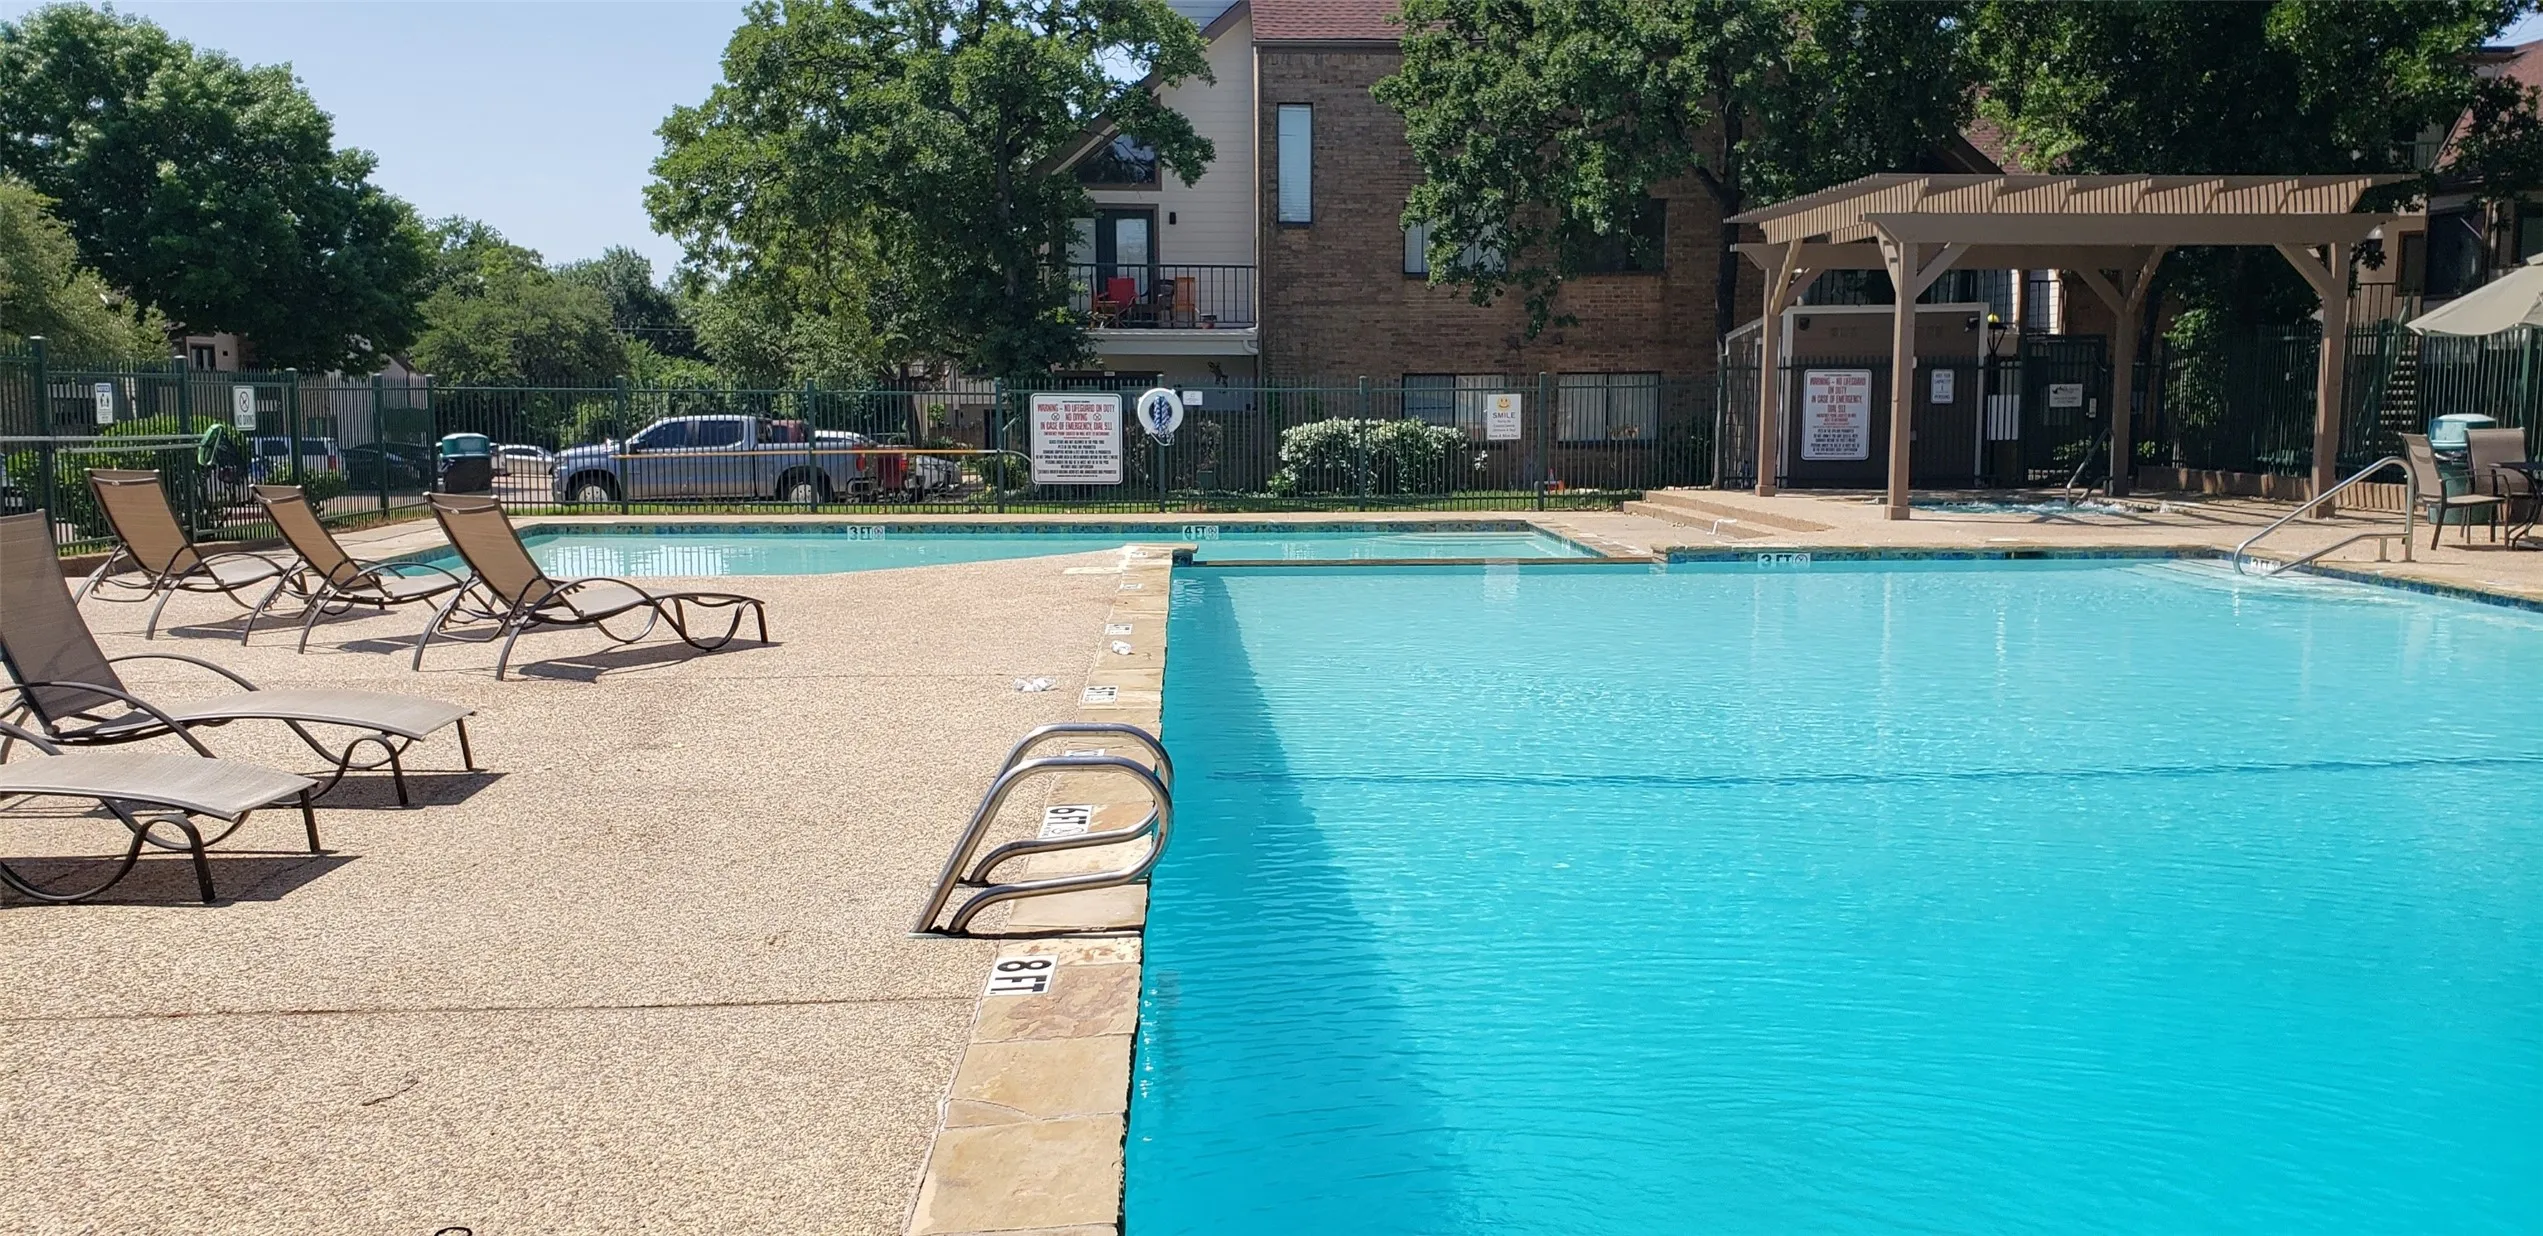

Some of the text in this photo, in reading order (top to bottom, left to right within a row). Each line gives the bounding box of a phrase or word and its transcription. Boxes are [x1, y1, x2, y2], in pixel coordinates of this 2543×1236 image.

[1037, 404, 1058, 412] WARNING
[1064, 404, 1070, 412] NO
[1072, 404, 1095, 412] LIFEGUARD
[1096, 404, 1102, 412] ON
[237, 414, 242, 426] NO
[1065, 413, 1087, 421] NO DIVING
[1041, 422, 1045, 430] IN
[1046, 422, 1058, 430] CASE
[1059, 422, 1064, 430] OF
[1094, 422, 1103, 430] DIAL
[850, 526, 872, 537] 3 FT
[1185, 526, 1206, 537] 4 FT
